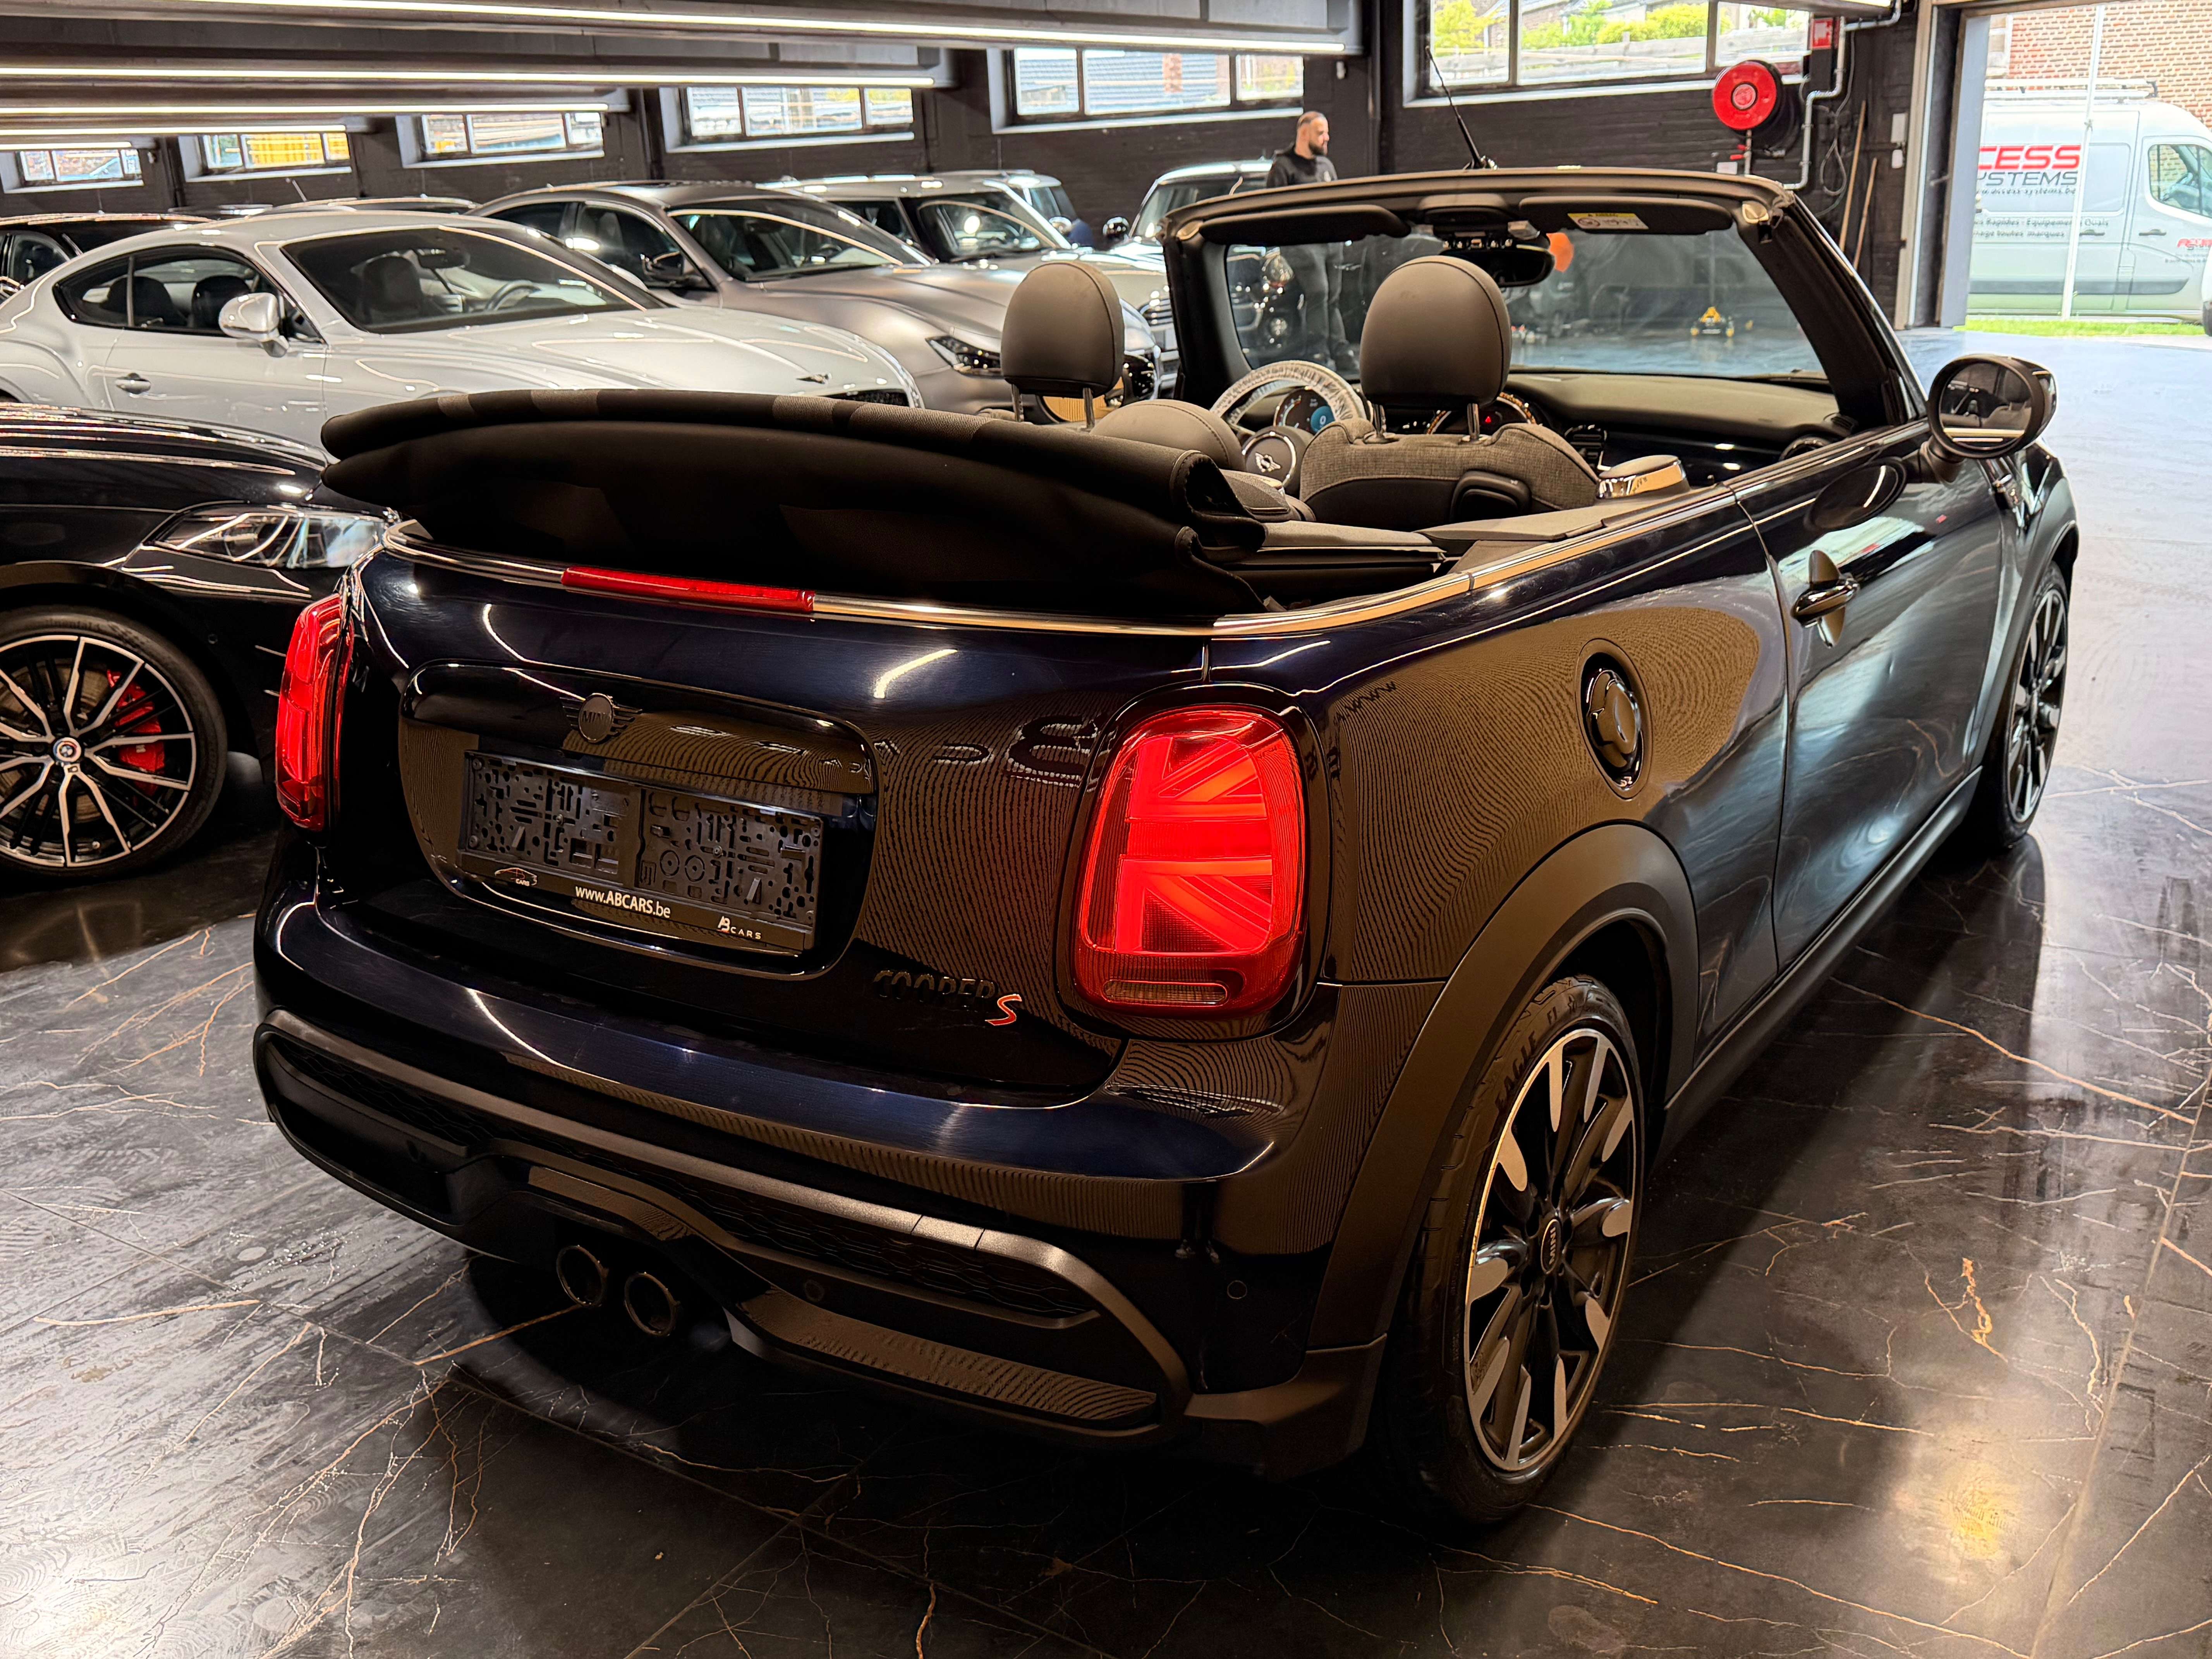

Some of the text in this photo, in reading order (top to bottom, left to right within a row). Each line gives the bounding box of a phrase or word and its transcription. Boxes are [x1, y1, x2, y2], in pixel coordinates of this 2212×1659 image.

[575, 886, 671, 919] www.ABCARS.be
[730, 926, 761, 939] CARS
[984, 993, 1022, 1026] S
